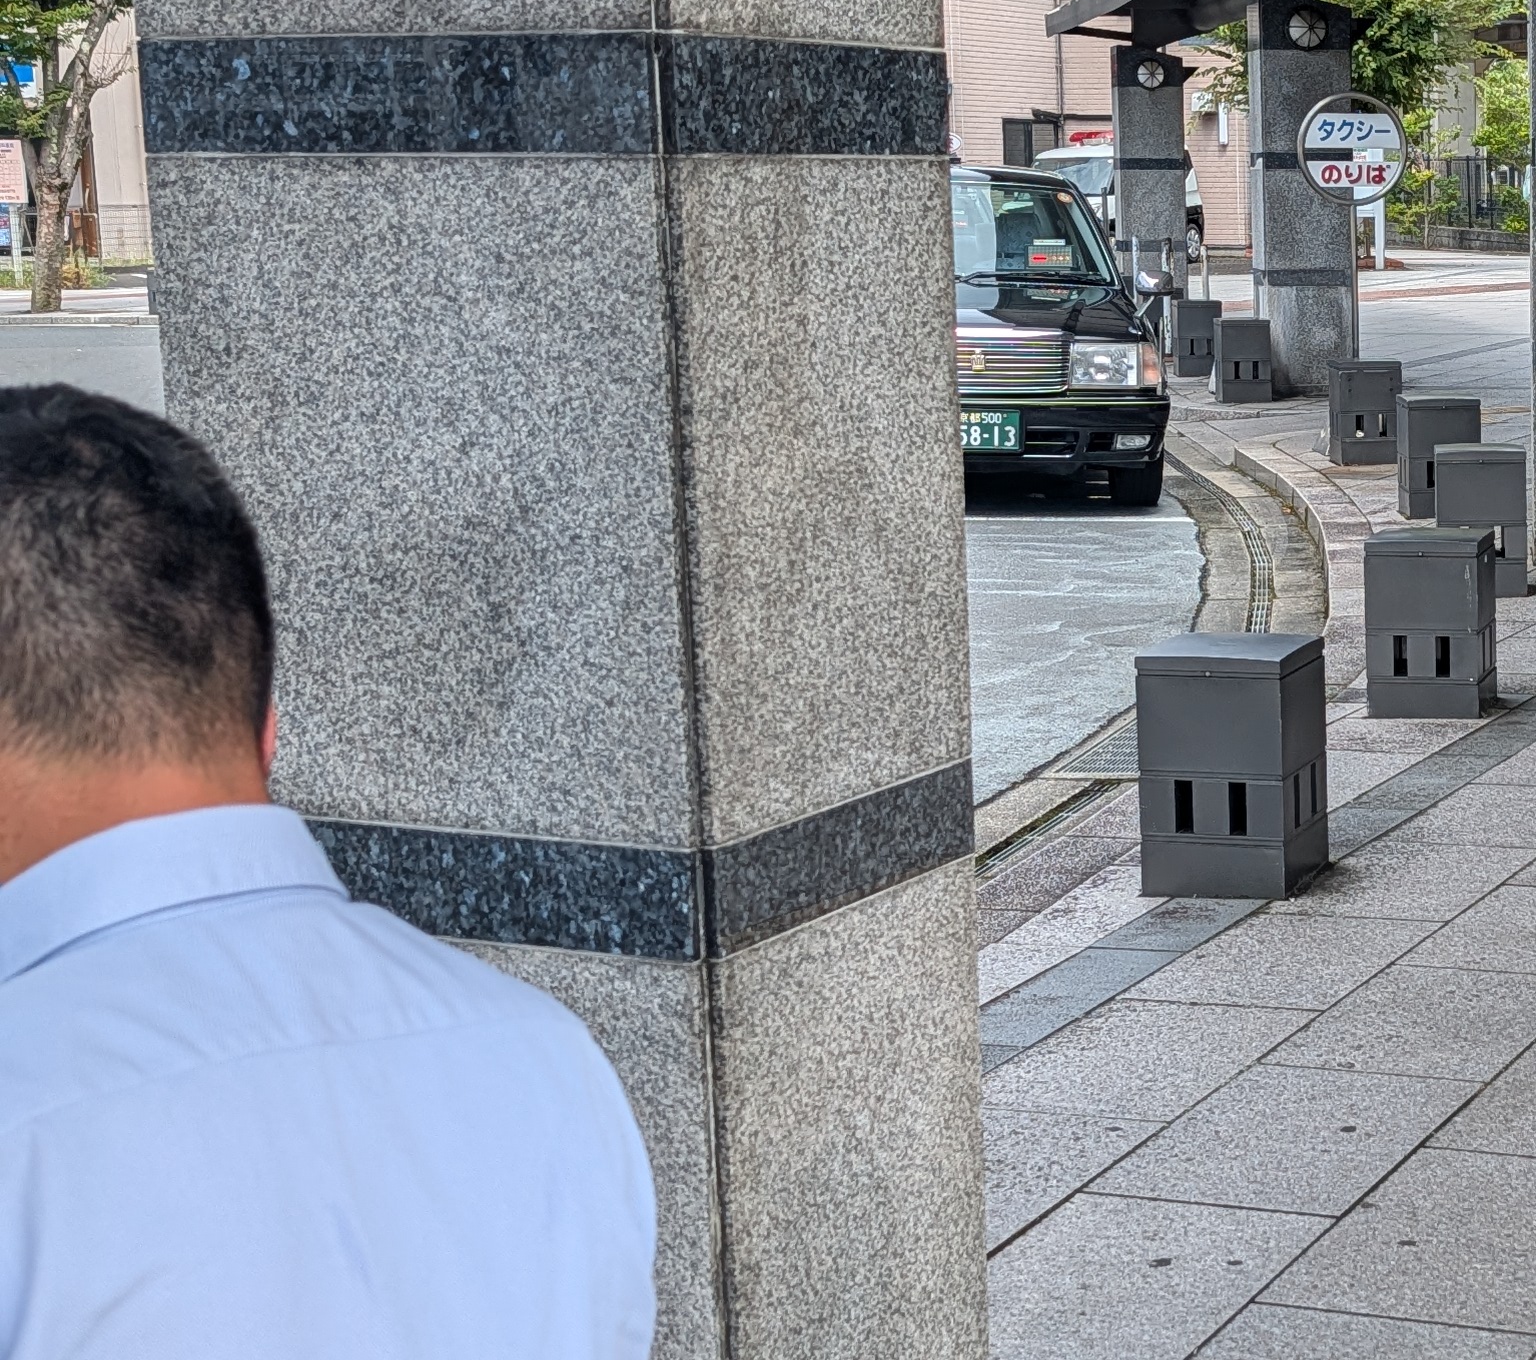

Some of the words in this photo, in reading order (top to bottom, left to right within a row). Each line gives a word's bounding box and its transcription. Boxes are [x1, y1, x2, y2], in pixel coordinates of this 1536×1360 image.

[1317, 119, 1391, 142] タクシー
[1321, 164, 1391, 185] のりば
